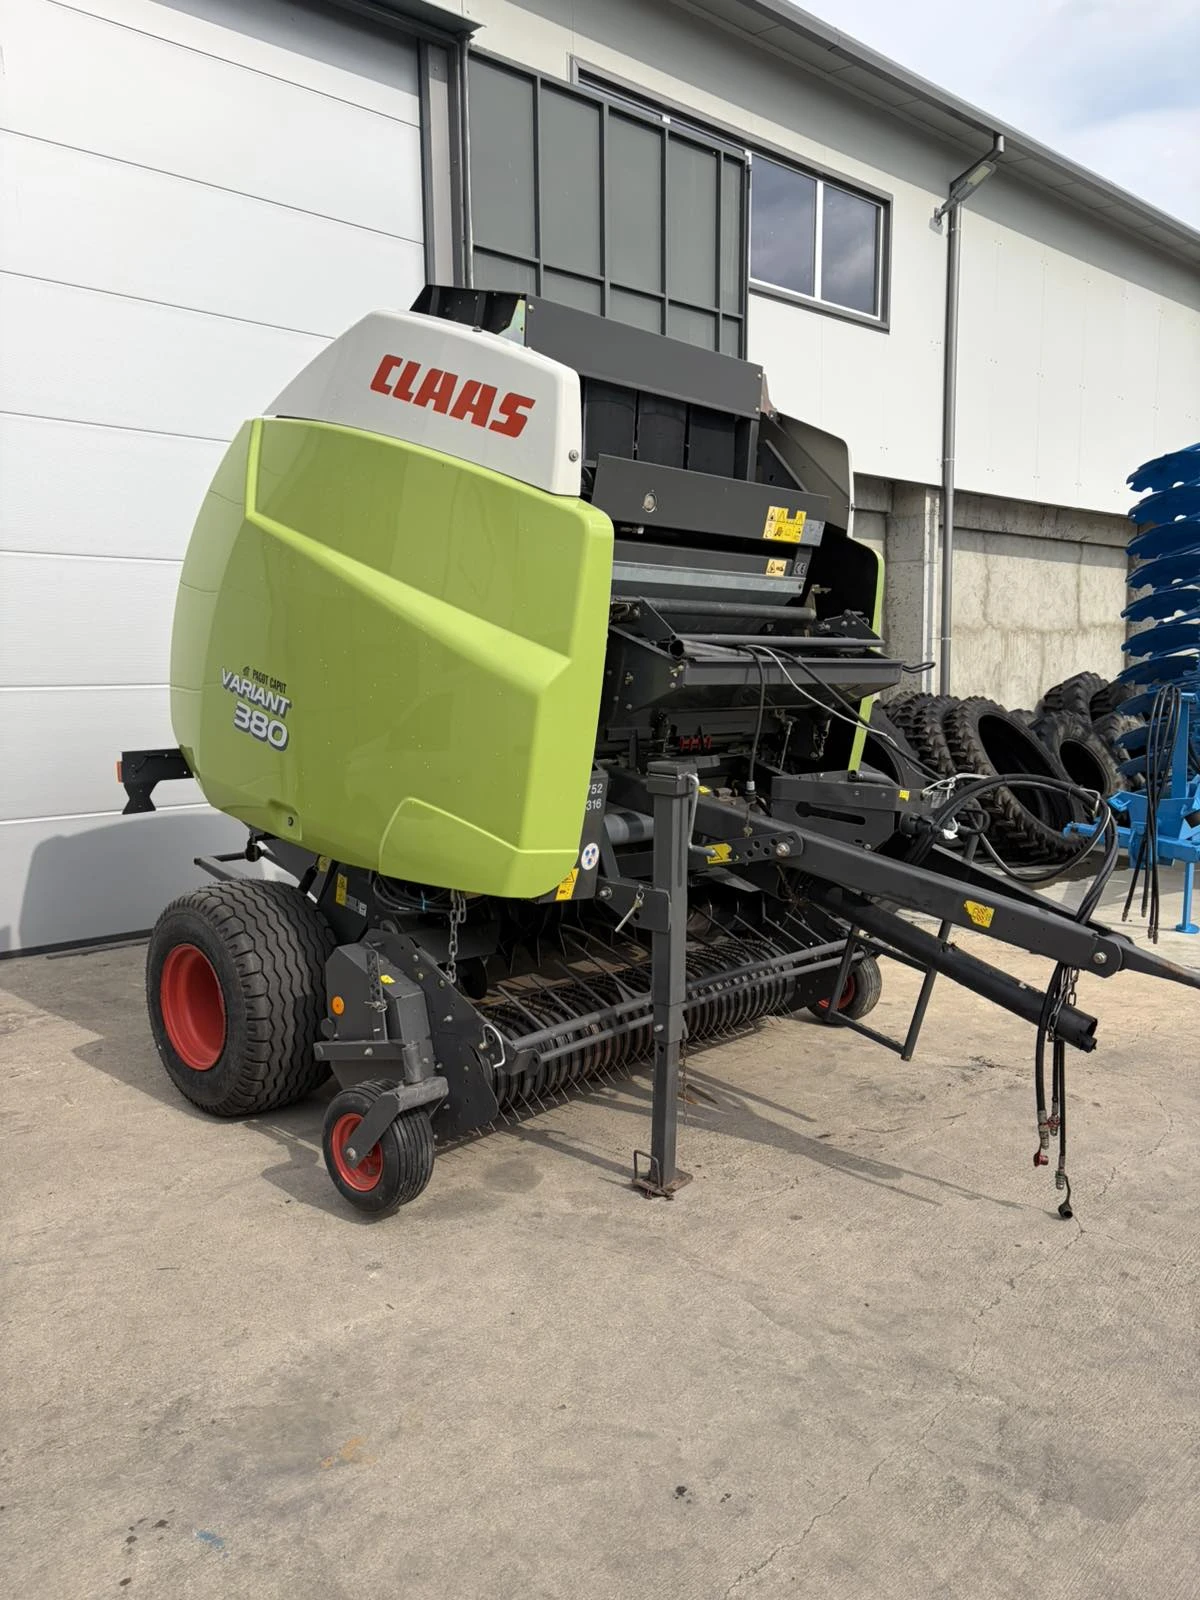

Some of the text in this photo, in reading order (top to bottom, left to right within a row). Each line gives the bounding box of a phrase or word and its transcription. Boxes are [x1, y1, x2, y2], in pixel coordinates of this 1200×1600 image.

[370, 354, 536, 438] CLAAS
[221, 667, 291, 719] VARIANT
[234, 701, 289, 751] 380
